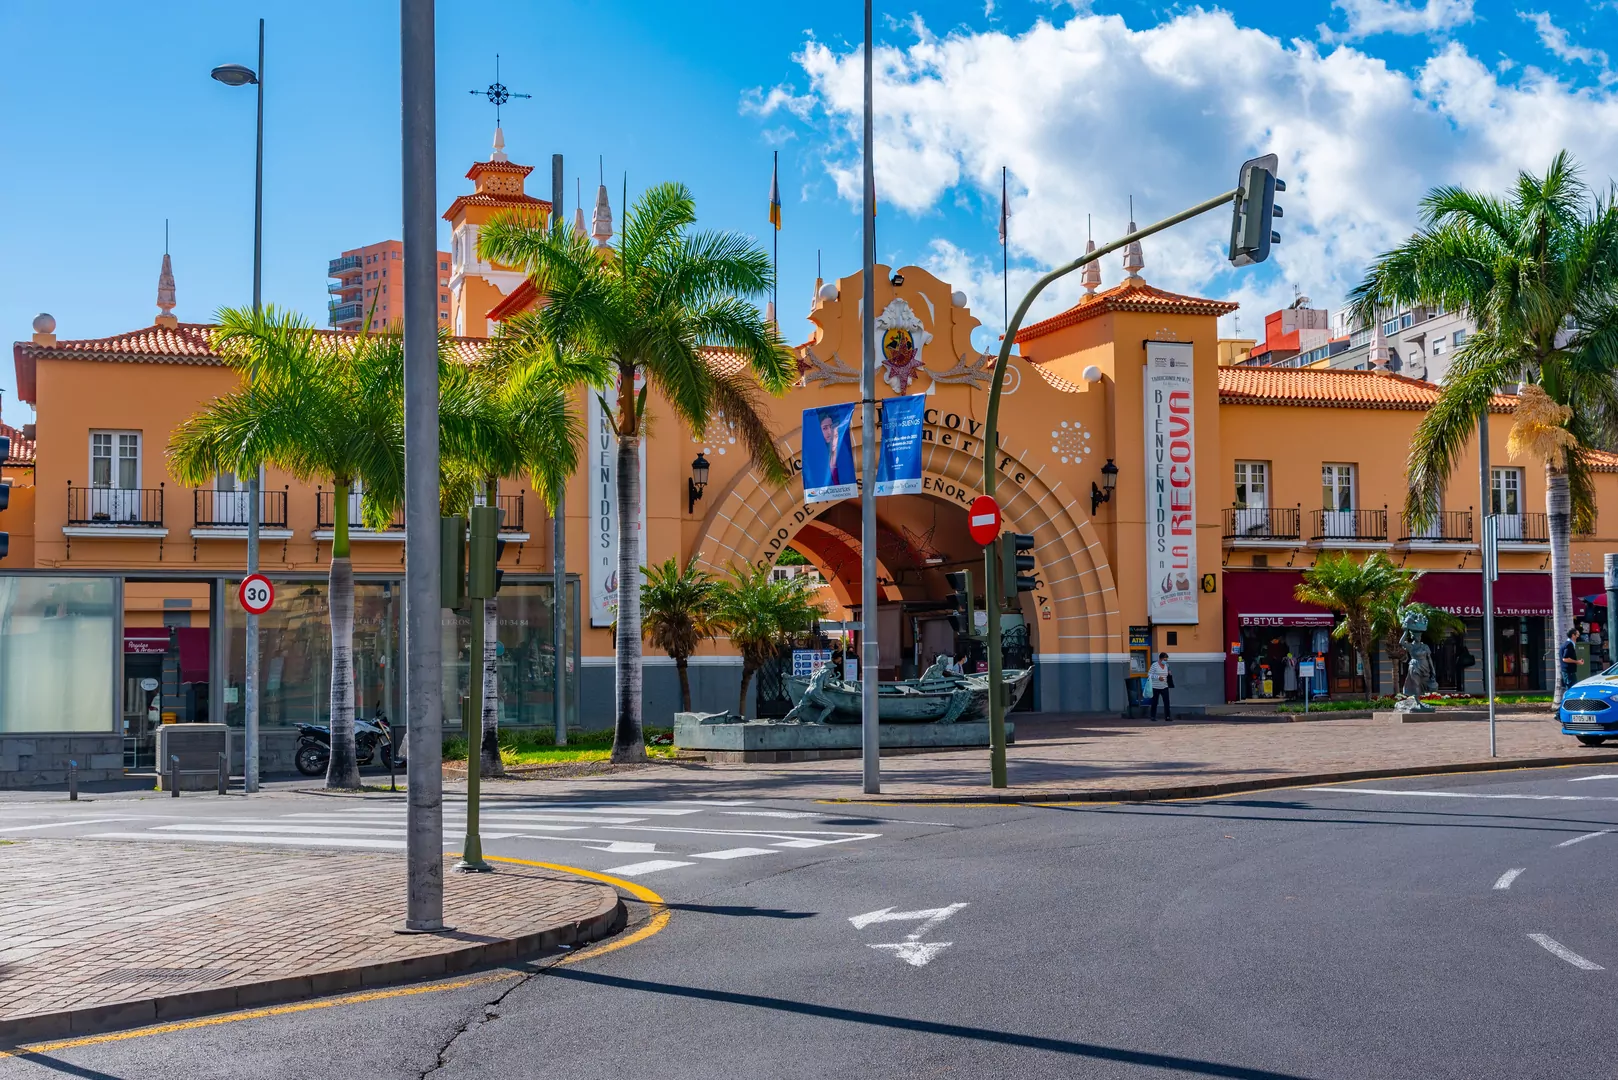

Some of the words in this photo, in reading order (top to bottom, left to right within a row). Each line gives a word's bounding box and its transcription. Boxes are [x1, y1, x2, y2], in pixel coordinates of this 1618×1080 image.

[1154, 389, 1165, 553] BIENVENIDOS
[1169, 389, 1192, 536] RECOVA
[923, 477, 977, 506] EÑORA
[757, 528, 789, 572] CADO
[793, 503, 815, 524] DE
[1172, 546, 1188, 569] LA
[247, 587, 267, 602] 30
[1243, 616, 1284, 625] B.STYLE
